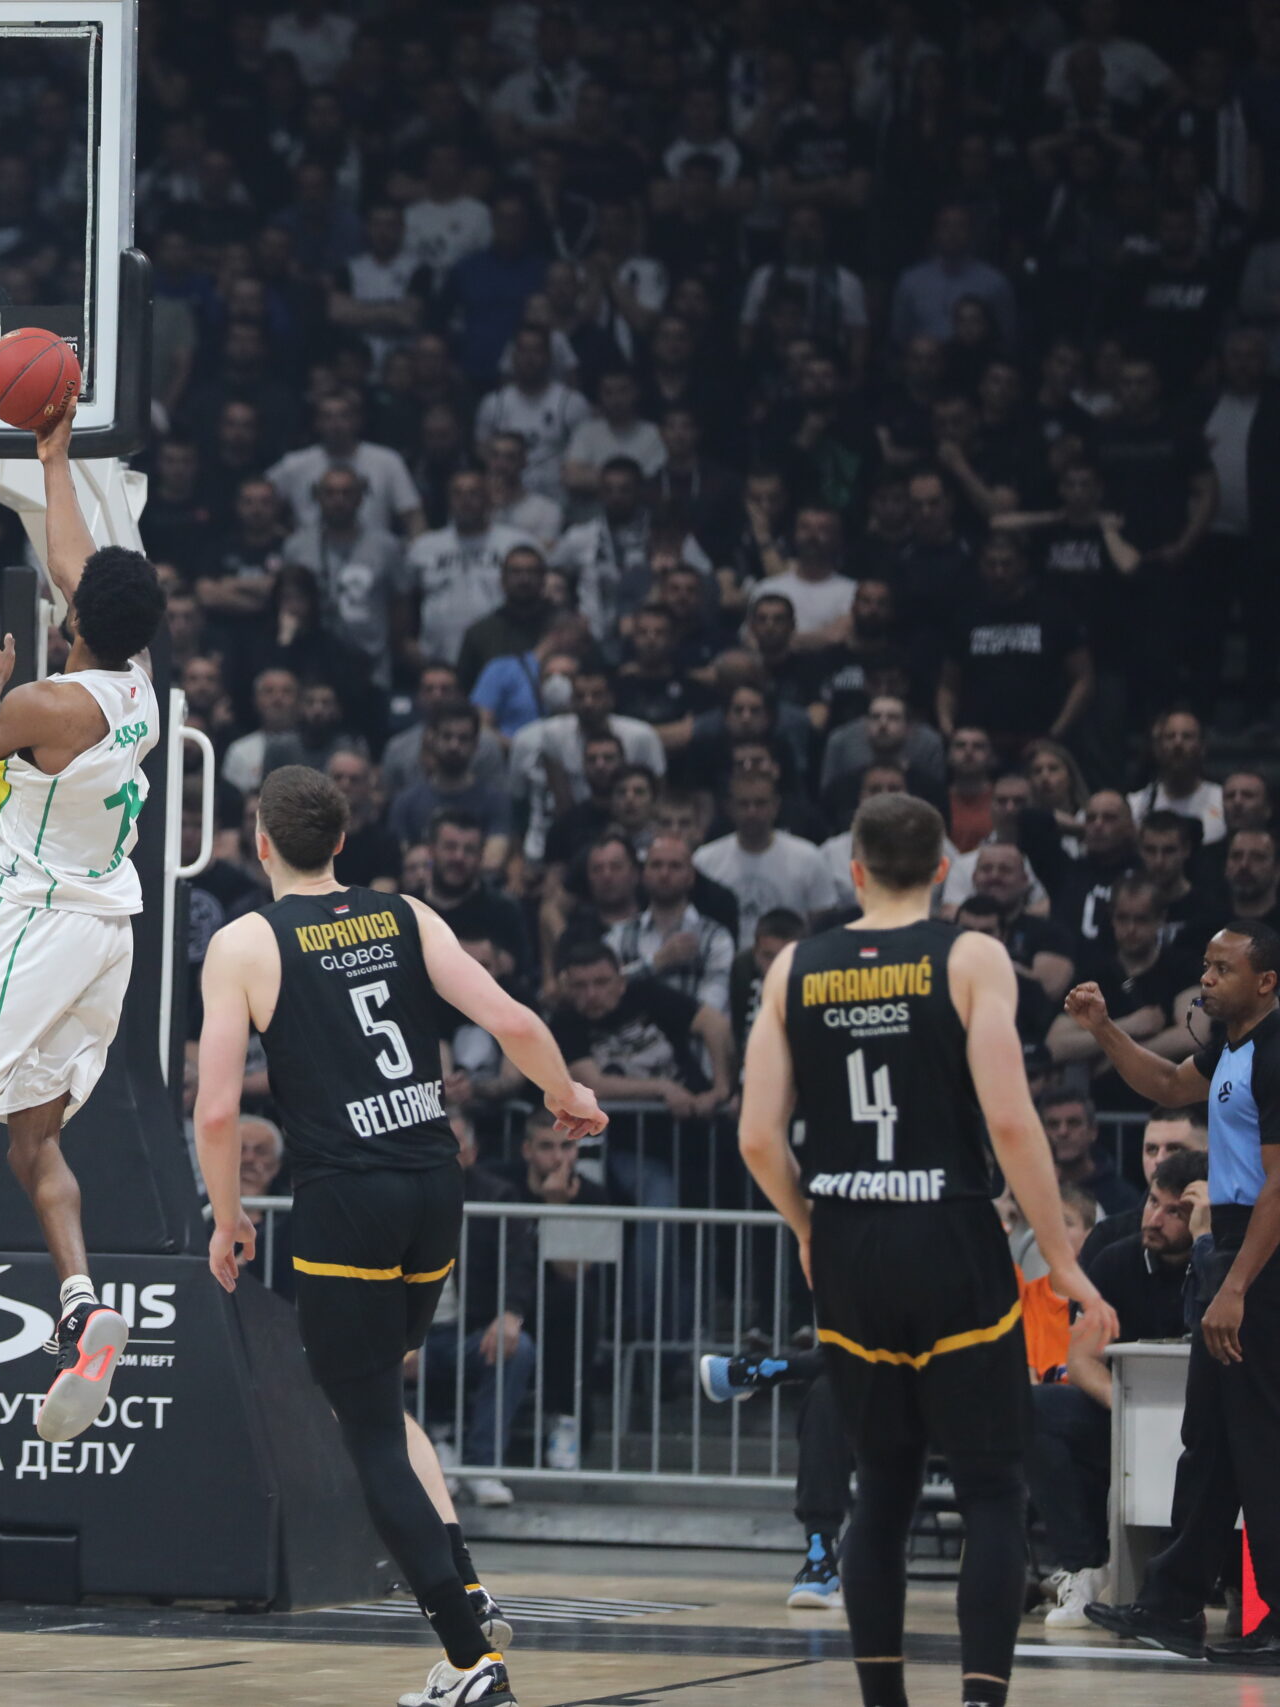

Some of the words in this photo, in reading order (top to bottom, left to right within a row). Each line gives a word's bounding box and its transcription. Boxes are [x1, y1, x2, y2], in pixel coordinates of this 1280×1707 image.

[295, 911, 400, 952] KOPRIVICA
[320, 943, 394, 971] GLOBOS
[346, 960, 398, 978] OSIGURANJE
[803, 955, 932, 1006] AVRAMOVIĆ
[349, 980, 413, 1080] 5
[823, 1002, 910, 1027] GLOBOS
[847, 1048, 898, 1162] 4
[101, 1283, 176, 1329] IS
[141, 1355, 176, 1367] NEFT
[15, 1440, 136, 1480] ДЕЛУ
